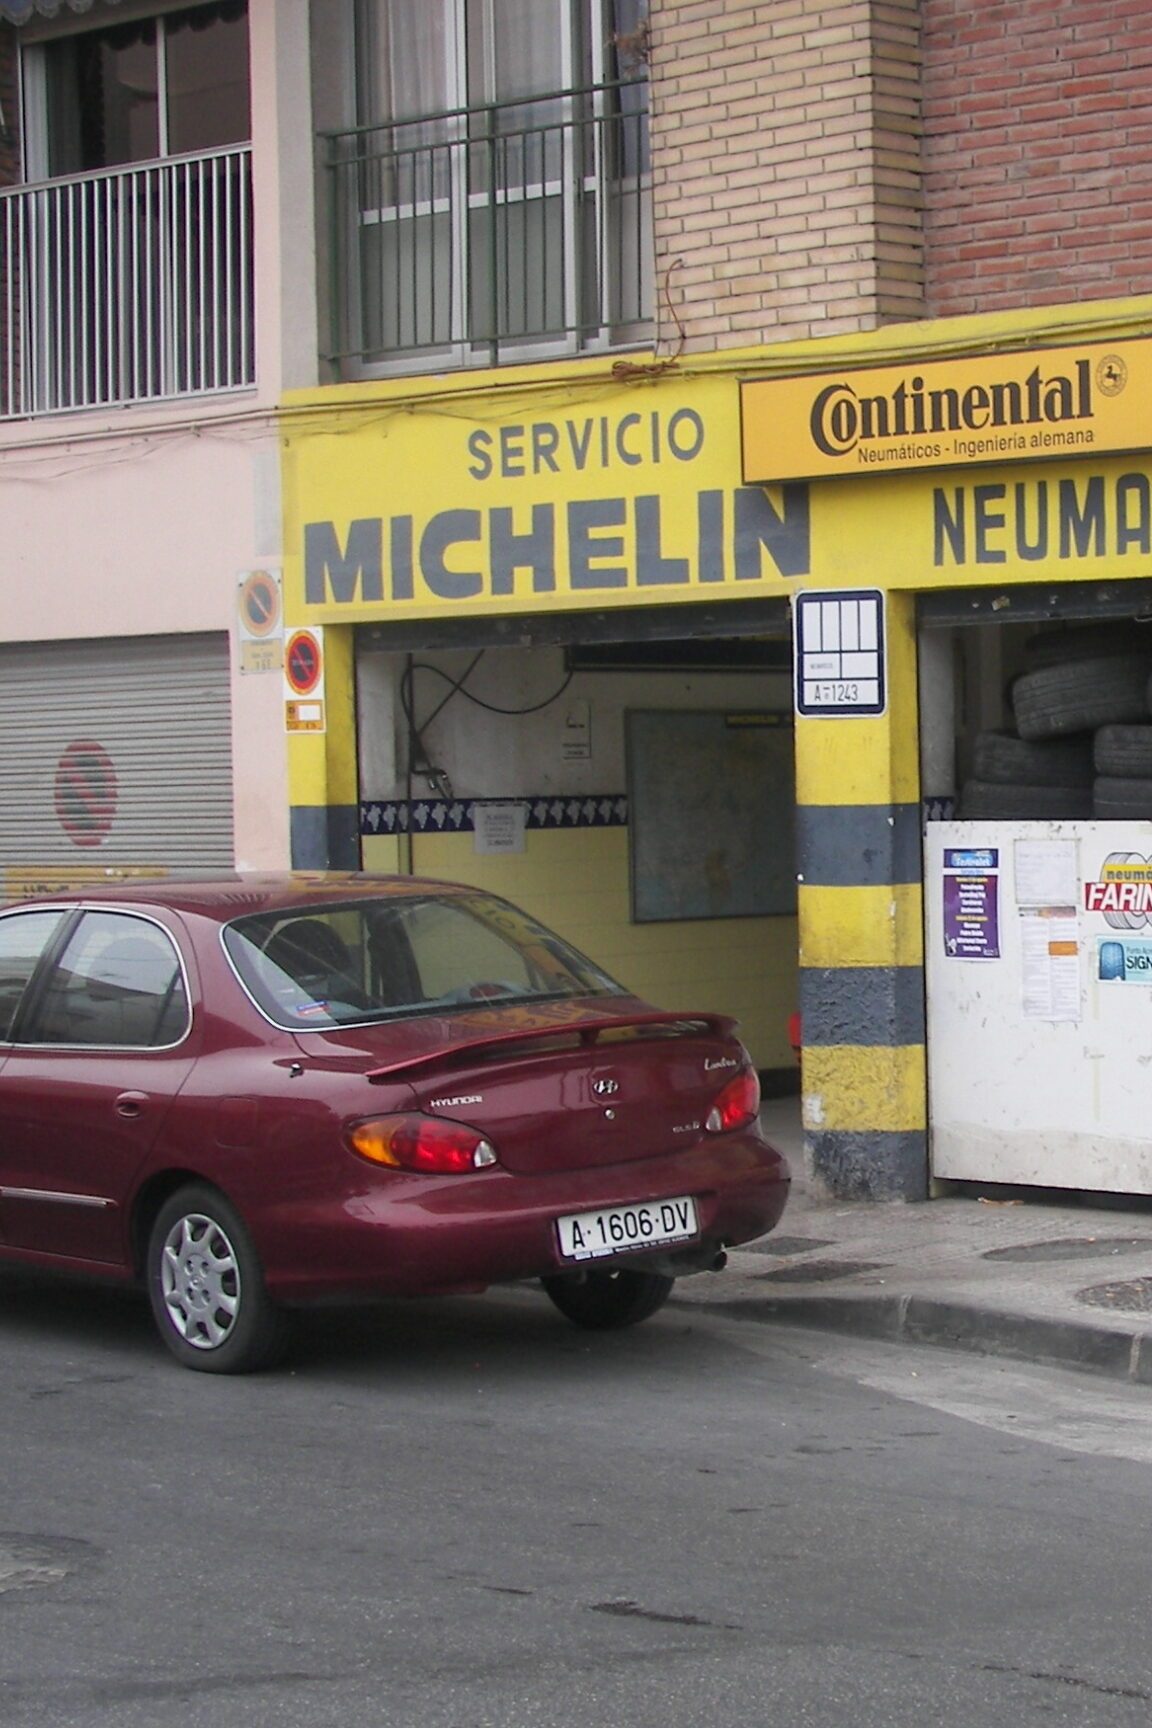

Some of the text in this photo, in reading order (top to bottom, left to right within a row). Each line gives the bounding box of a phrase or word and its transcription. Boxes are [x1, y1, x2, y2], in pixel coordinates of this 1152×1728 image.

[467, 408, 705, 481] SERVICIO
[810, 359, 1095, 457] Continental
[858, 442, 942, 464] Neumáticos
[1029, 429, 1095, 448] alemana
[304, 487, 811, 604] MICHELIN
[430, 1095, 483, 1108] HYUNDAI
